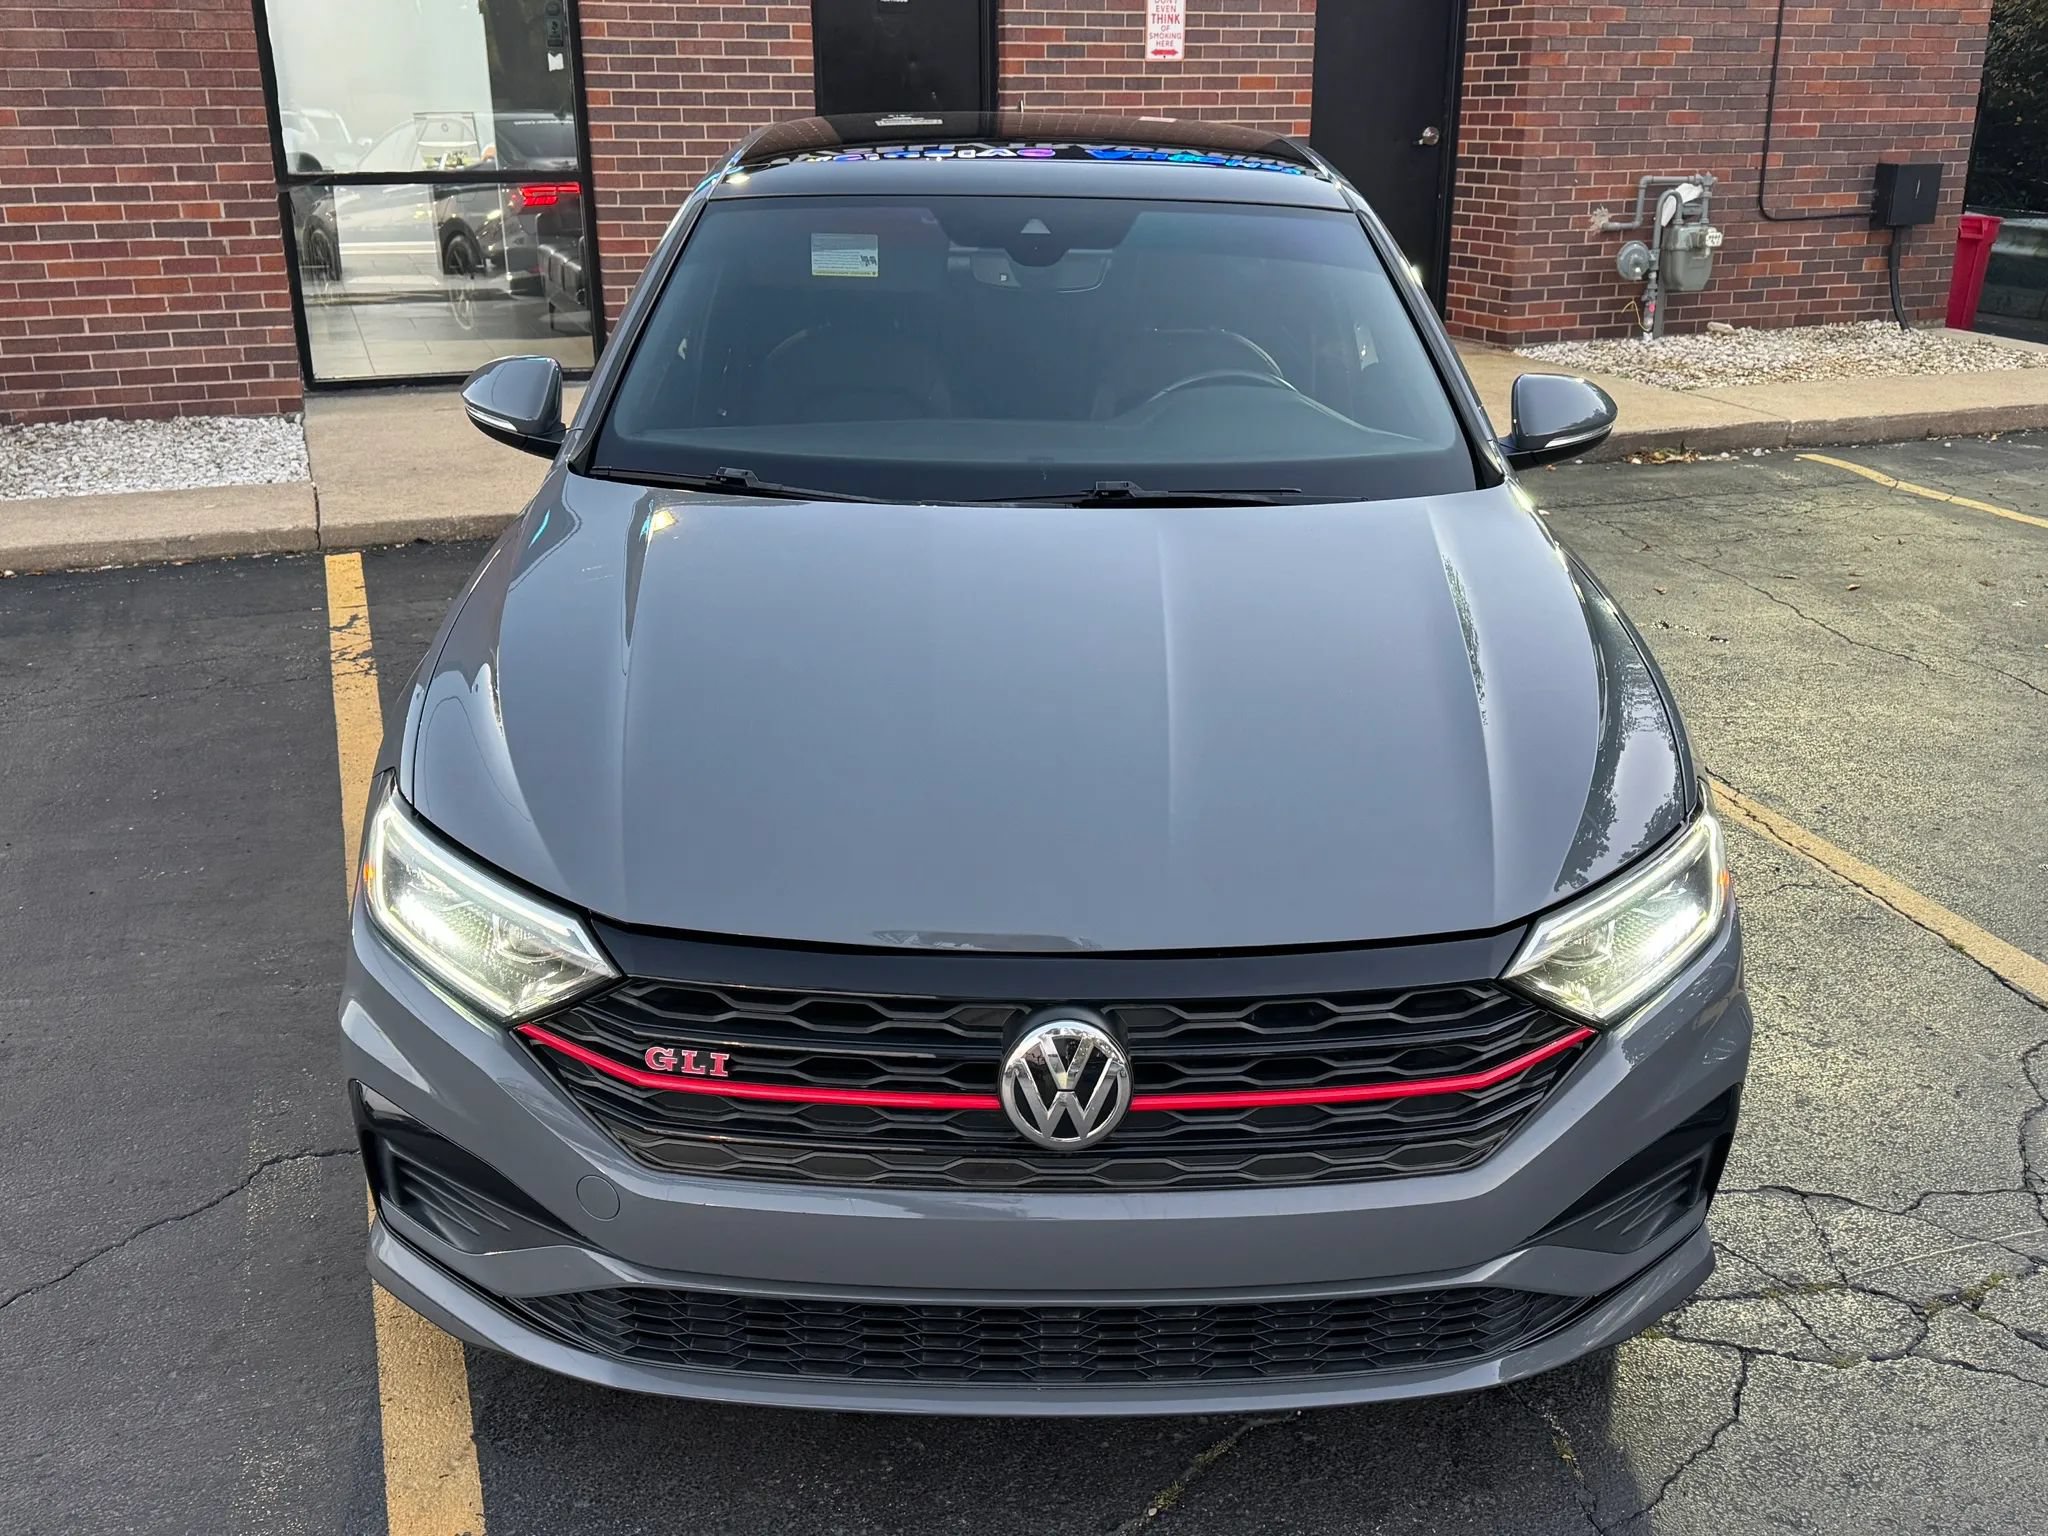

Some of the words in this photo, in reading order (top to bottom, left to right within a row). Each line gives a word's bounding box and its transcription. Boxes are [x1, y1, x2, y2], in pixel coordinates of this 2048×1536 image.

[1152, 13, 1180, 24] THINK
[645, 1047, 729, 1077] GLI
[1006, 1025, 1128, 1147] VW
